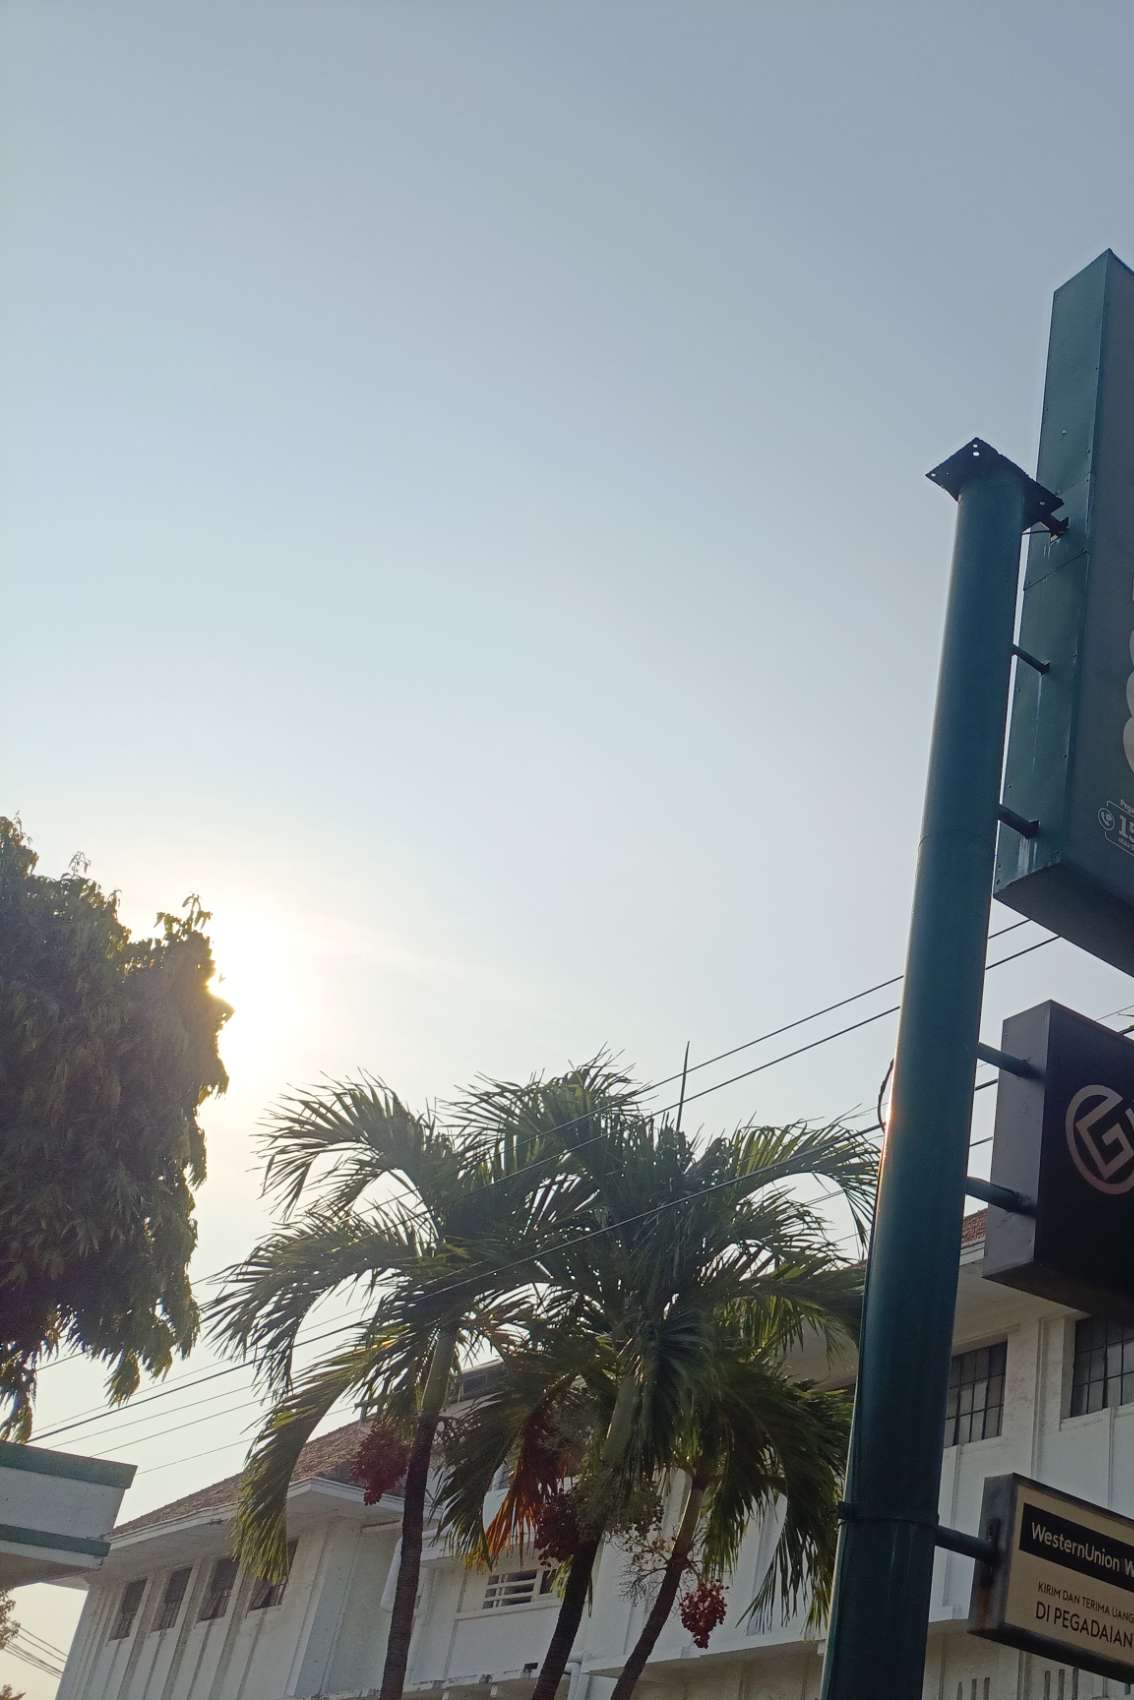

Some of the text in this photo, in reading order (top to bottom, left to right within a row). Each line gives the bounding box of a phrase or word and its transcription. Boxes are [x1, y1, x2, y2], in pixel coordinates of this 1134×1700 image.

[1036, 1601, 1134, 1649] DI PEGADAIAN
[1037, 1581, 1134, 1624] KIRIM DAN TERIMA UANG
